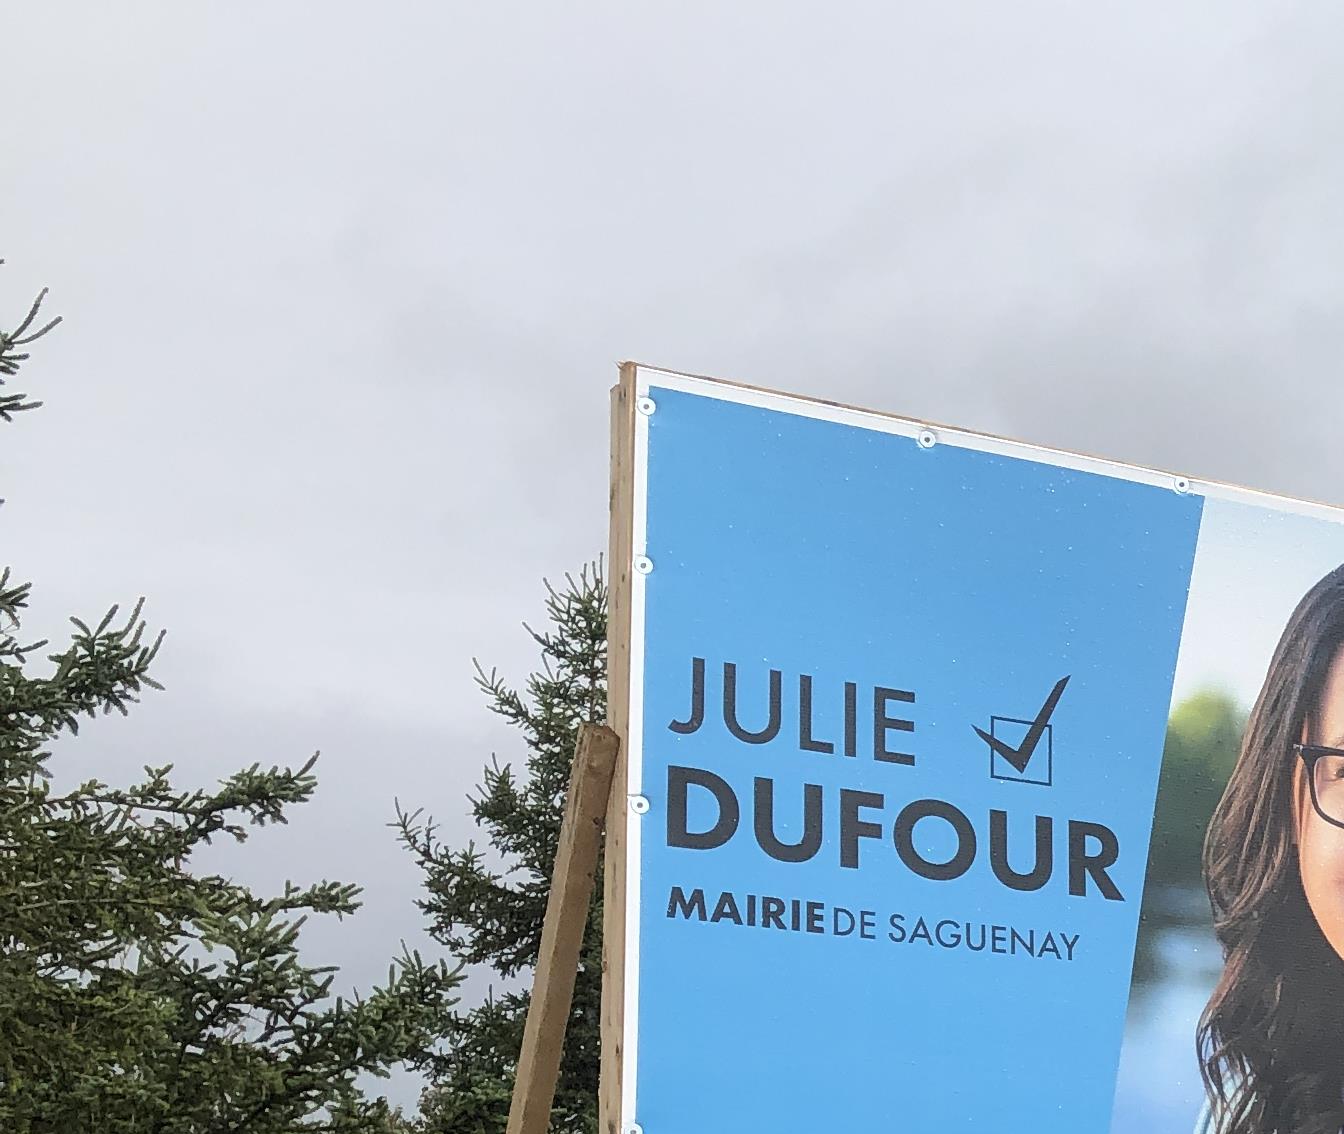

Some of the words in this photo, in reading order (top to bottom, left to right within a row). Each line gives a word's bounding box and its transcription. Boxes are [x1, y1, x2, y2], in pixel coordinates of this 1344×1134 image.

[668, 657, 916, 766] JULIE
[666, 765, 1126, 901] DUFOUR
[666, 886, 825, 933] MAIRIE
[833, 907, 877, 939] DE
[888, 913, 1080, 961] SAGUENAY
